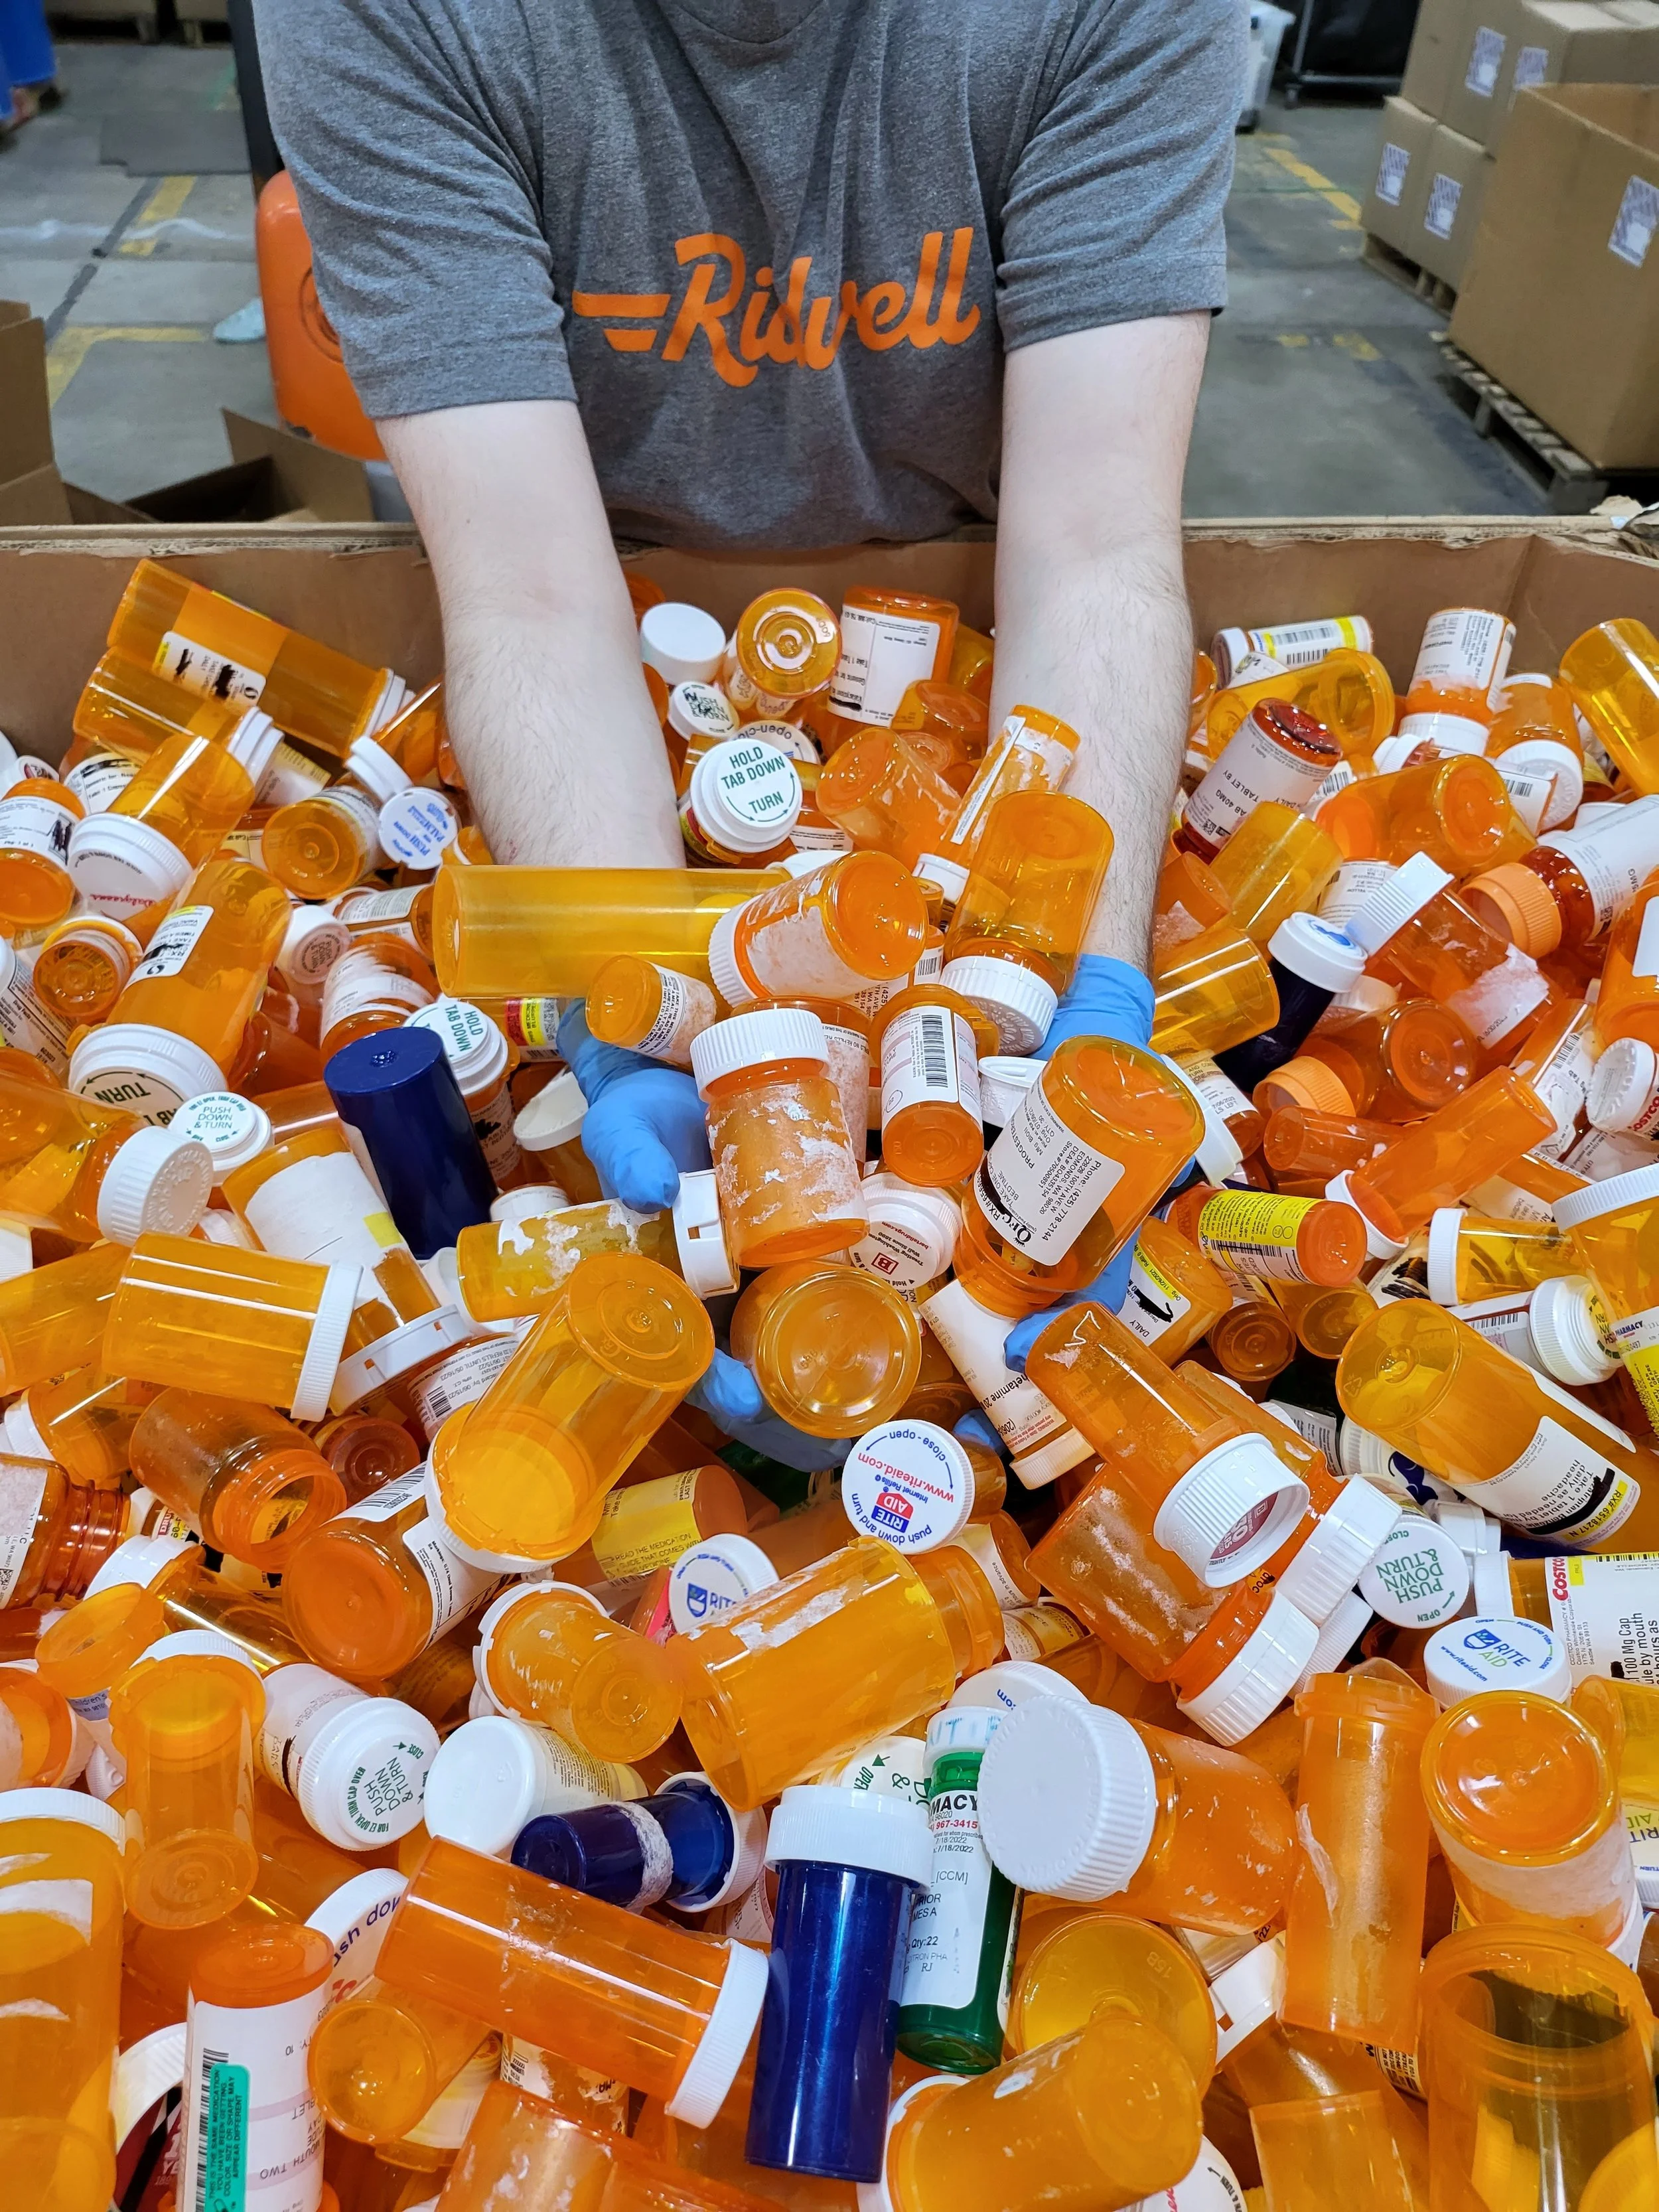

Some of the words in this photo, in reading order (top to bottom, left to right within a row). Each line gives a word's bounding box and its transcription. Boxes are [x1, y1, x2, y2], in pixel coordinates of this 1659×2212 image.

[729, 746, 763, 769] HOLD
[721, 772, 745, 790] TAB
[748, 755, 786, 781] DOWN
[1222, 770, 1232, 779] BY
[1215, 789, 1234, 808] 40MG
[1231, 779, 1260, 802] TABLET
[749, 791, 784, 814] TURN
[445, 1005, 460, 1022] TAB
[465, 1011, 483, 1035] HOLD
[451, 1023, 472, 1051] DOWN
[94, 1082, 151, 1104] TURN
[1633, 1096, 1659, 1131] OSTCO
[1064, 1145, 1079, 1165] DEA#
[1078, 1156, 1092, 1174] 22828
[1080, 1160, 1102, 1186] Phone:
[999, 1170, 1019, 1201] BEDTIME
[1051, 1185, 1063, 1197] WA
[1066, 1174, 1080, 1193] 100TH
[1039, 1197, 1054, 1215] 98020
[1056, 1193, 1067, 1207] AVE
[1067, 1188, 1082, 1208] (425)
[1050, 1205, 1058, 1214] W
[1041, 1209, 1068, 1241] 778-2144
[868, 1233, 900, 1253] Washington
[878, 1232, 891, 1242] 1890
[882, 1221, 928, 1250] bartelldrugs.com
[893, 1238, 907, 1250] Since
[901, 1250, 923, 1266] Treating
[907, 1248, 920, 1257] Well
[878, 1257, 894, 1270] B
[1129, 1319, 1150, 1337] DAILY
[890, 1429, 916, 1439] open
[923, 1438, 946, 1461] close
[858, 1452, 954, 1503] www.riteaid.com
[882, 1477, 901, 1491] Refills
[1541, 1459, 1581, 1501] headache
[1569, 1464, 1586, 1489] daily
[1575, 1471, 1594, 1494] Take
[902, 1487, 928, 1504] Internet
[1558, 1490, 1569, 1499] as
[1608, 1490, 1621, 1509] RX#
[851, 1493, 863, 1515] turn
[883, 1496, 908, 1513] AID
[1519, 1500, 1556, 1516] needed
[1538, 1502, 1568, 1519] tablet
[859, 1515, 877, 1532] and
[875, 1509, 905, 1530] RITE
[1579, 1509, 1609, 1533] 6518217
[879, 1530, 905, 1546] down
[908, 1524, 932, 1544] push
[614, 1551, 634, 1561] READ
[635, 1546, 648, 1555] THE
[649, 1532, 691, 1550] MEDICATION
[640, 1552, 658, 1563] THAT
[658, 1544, 685, 1558] COMES
[1421, 1548, 1438, 1562] &
[1376, 1553, 1425, 1579] TURN
[1384, 1562, 1444, 1592] DOWN
[1395, 1578, 1444, 1603] PUSH
[1417, 1609, 1441, 1622] OPEN
[1561, 1611, 1571, 1643] PHARMACY
[1619, 1618, 1631, 1636] Cap
[1630, 1613, 1648, 1649] mouth
[1543, 1634, 1553, 1645] TURN
[1586, 1638, 1591, 1647] WA
[1622, 1639, 1636, 1655] Mg
[1441, 1646, 1488, 1682] www.riteaid.com
[1479, 1651, 1508, 1668] AID
[1493, 1643, 1532, 1667] RITE
[1539, 1657, 1553, 1670] CLOSE
[1640, 1653, 1653, 1666] by
[1624, 1658, 1637, 1674] 100
[407, 1743, 424, 1759] CLOSE
[352, 1766, 366, 1784] OVER
[387, 1756, 409, 1795] TURN
[892, 1773, 910, 1789] &
[348, 1786, 357, 1800] CAP
[364, 1779, 387, 1816] PUSH
[375, 1767, 401, 1811] DOWN
[402, 1792, 413, 1803] &
[348, 1800, 360, 1818] TURN
[930, 1795, 977, 1816] MACY
[378, 1822, 389, 1832] FOR
[936, 1819, 978, 1830] 967-3415
[936, 1871, 968, 1885] [CCM]
[234, 2095, 242, 2142] DIFFERENT
[226, 2129, 233, 2138] OR
[259, 2165, 287, 2179] TWO
